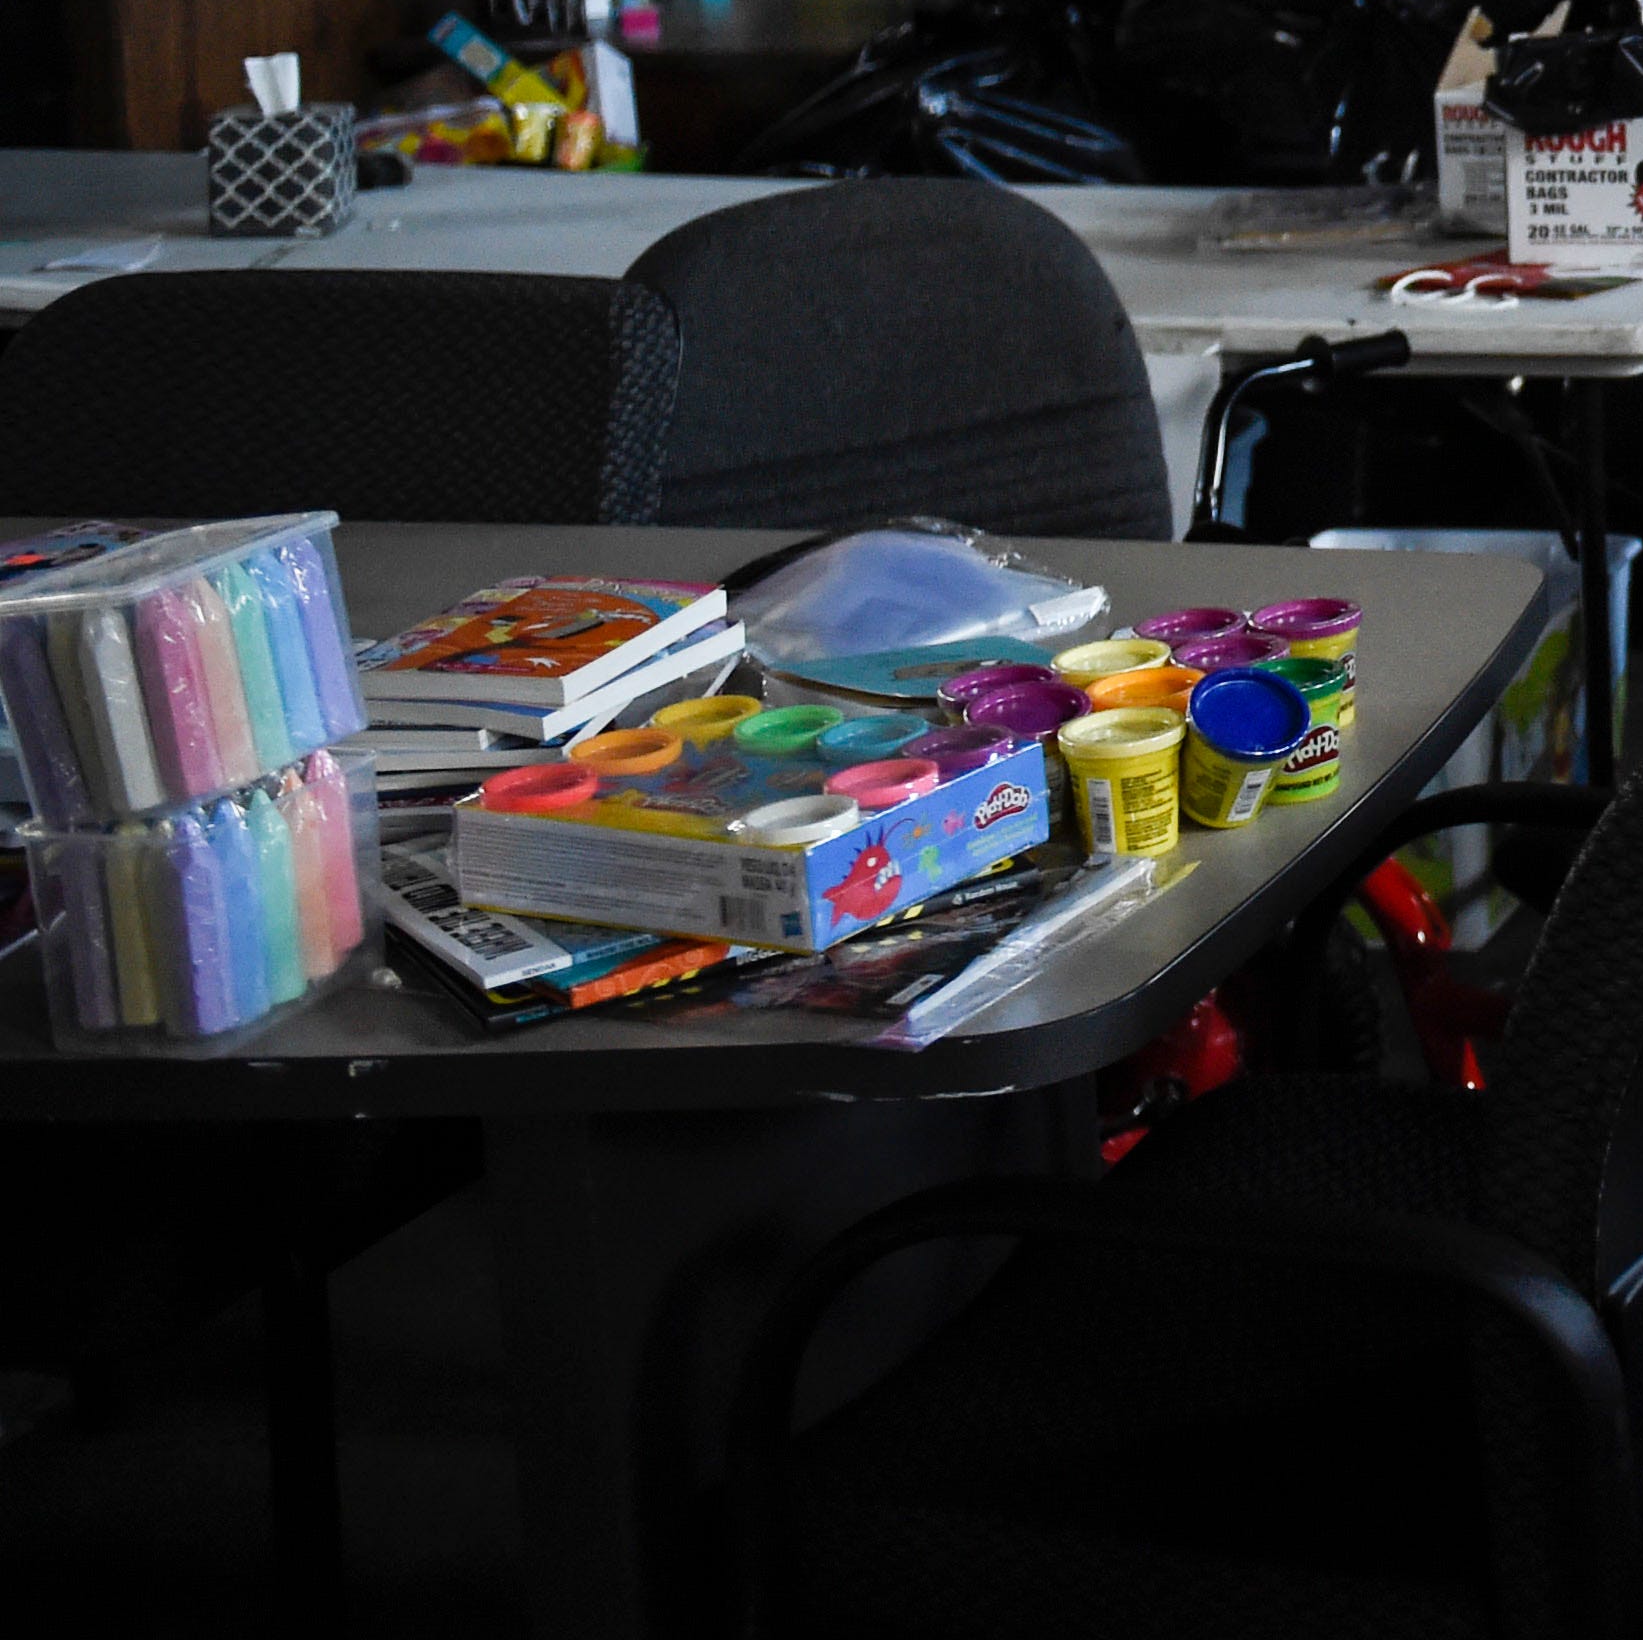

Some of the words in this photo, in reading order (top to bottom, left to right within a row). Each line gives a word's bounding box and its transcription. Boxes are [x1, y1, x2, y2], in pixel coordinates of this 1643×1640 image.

[1525, 170, 1629, 183] CONTRACTOR
[1526, 186, 1568, 200] BAGS
[1543, 203, 1569, 215] MIL
[1527, 225, 1550, 239] 20
[974, 785, 1031, 830] Play-Doh
